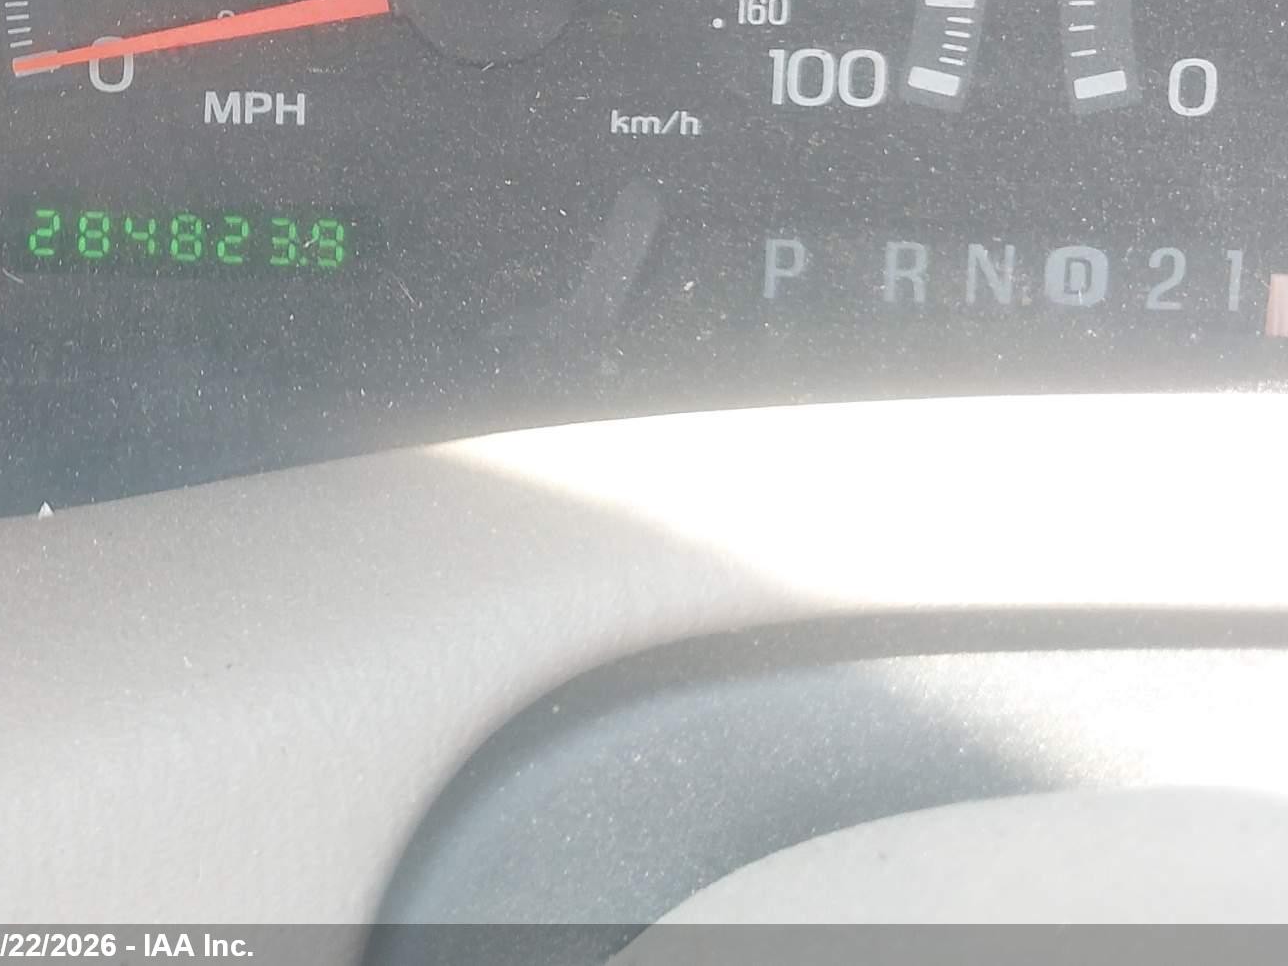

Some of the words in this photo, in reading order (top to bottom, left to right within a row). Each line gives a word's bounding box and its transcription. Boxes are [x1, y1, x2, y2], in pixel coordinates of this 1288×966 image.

[768, 48, 887, 108] 100
[1168, 58, 1217, 116] 0
[203, 92, 307, 127] MPH
[609, 106, 702, 139] km/h
[763, 238, 807, 299] P
[883, 240, 929, 303] R
[966, 243, 1013, 303] N
[1145, 247, 1187, 311] 2
[1225, 249, 1243, 311] 1
